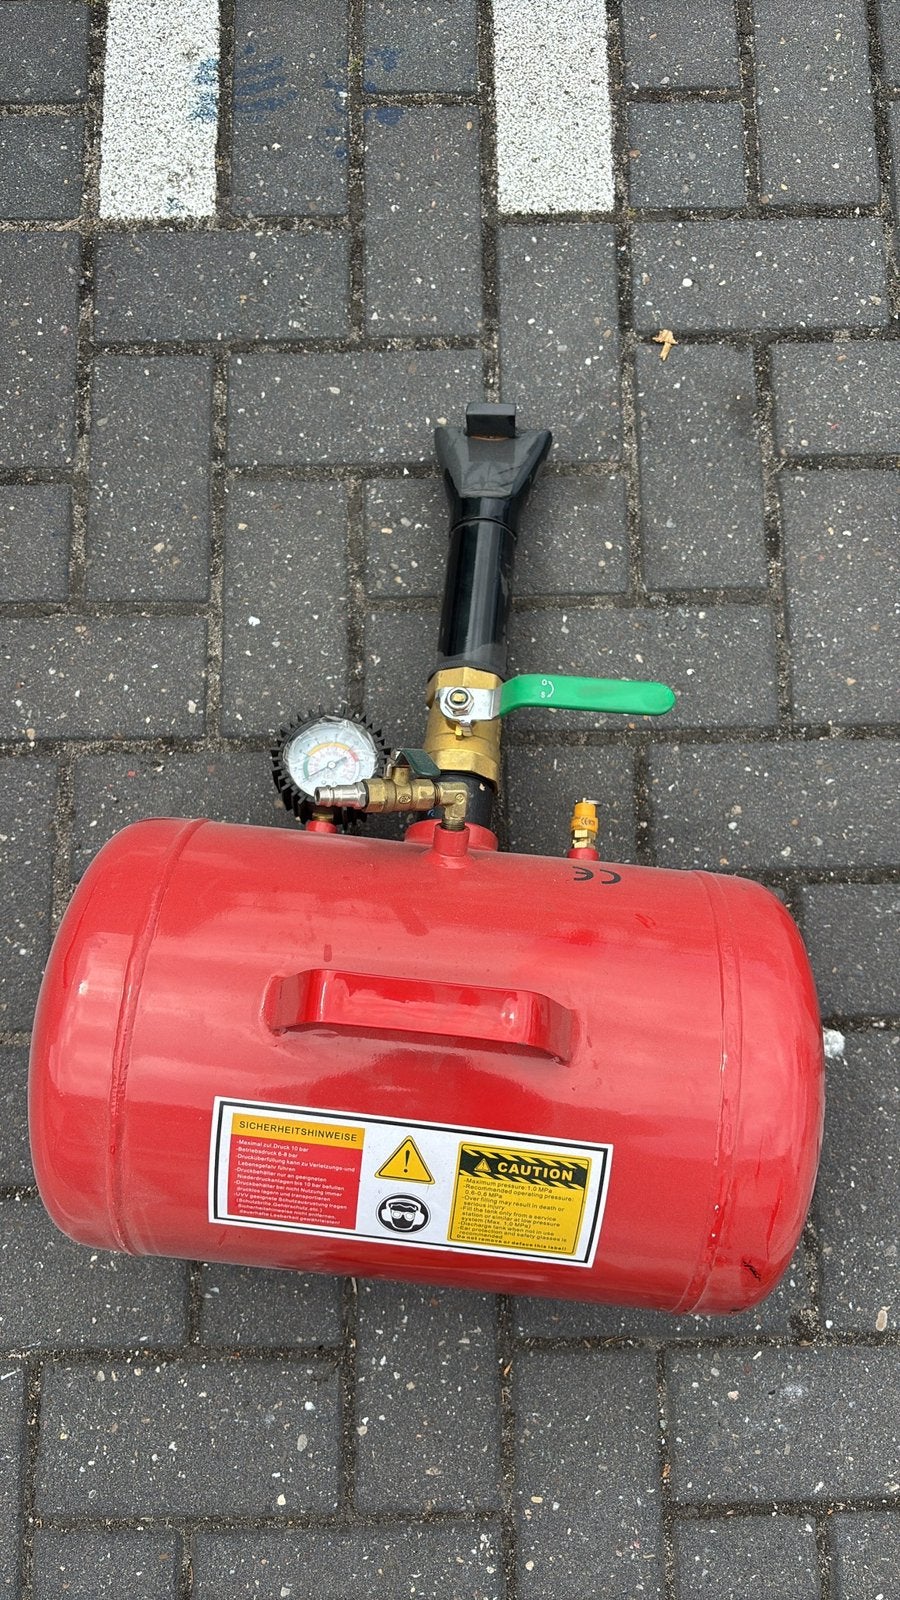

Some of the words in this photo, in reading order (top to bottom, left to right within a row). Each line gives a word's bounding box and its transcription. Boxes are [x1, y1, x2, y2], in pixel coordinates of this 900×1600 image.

[572, 865, 622, 885] CE
[239, 1121, 357, 1141] SICHERHEITSHINWEISE
[295, 1174, 327, 1182] geeigneten
[497, 1162, 573, 1181] CAUTION
[513, 1190, 543, 1198] operating
